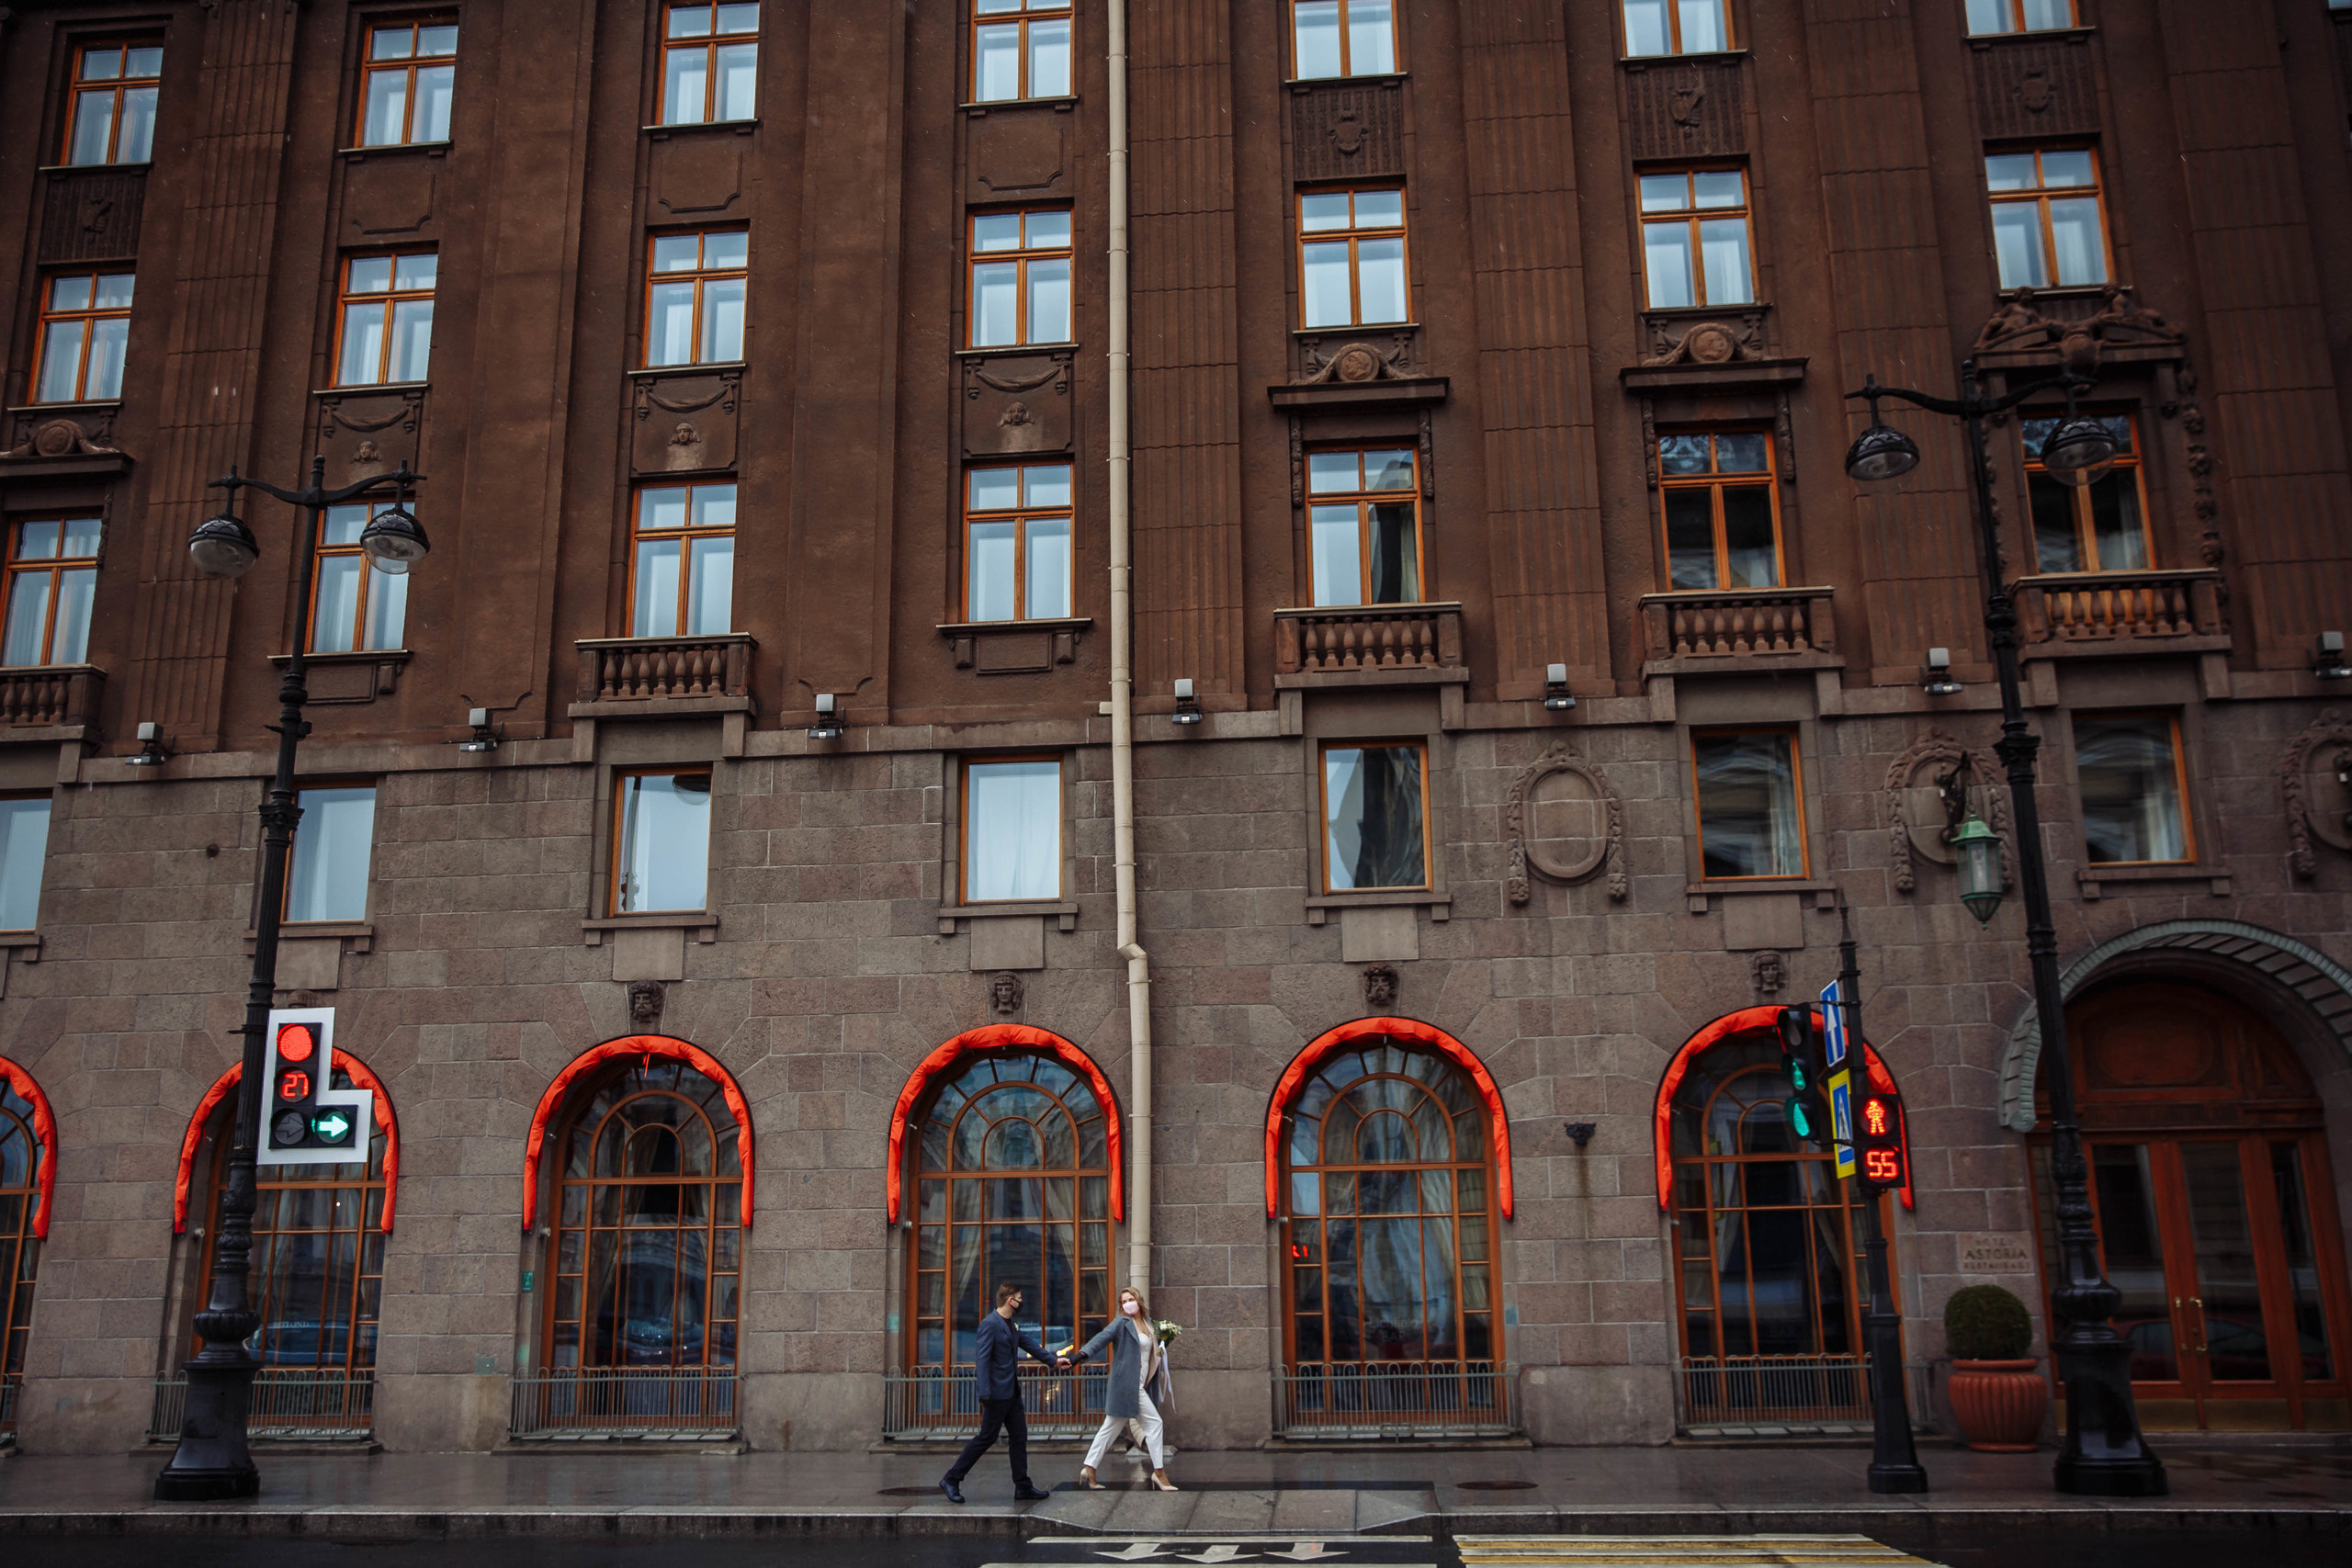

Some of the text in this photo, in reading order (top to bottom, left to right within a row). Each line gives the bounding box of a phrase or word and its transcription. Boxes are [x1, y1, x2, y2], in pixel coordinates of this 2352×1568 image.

[282, 1072, 310, 1098] 27
[1865, 1150, 1899, 1179] 55
[1965, 1248, 2028, 1259] ASTORIA
